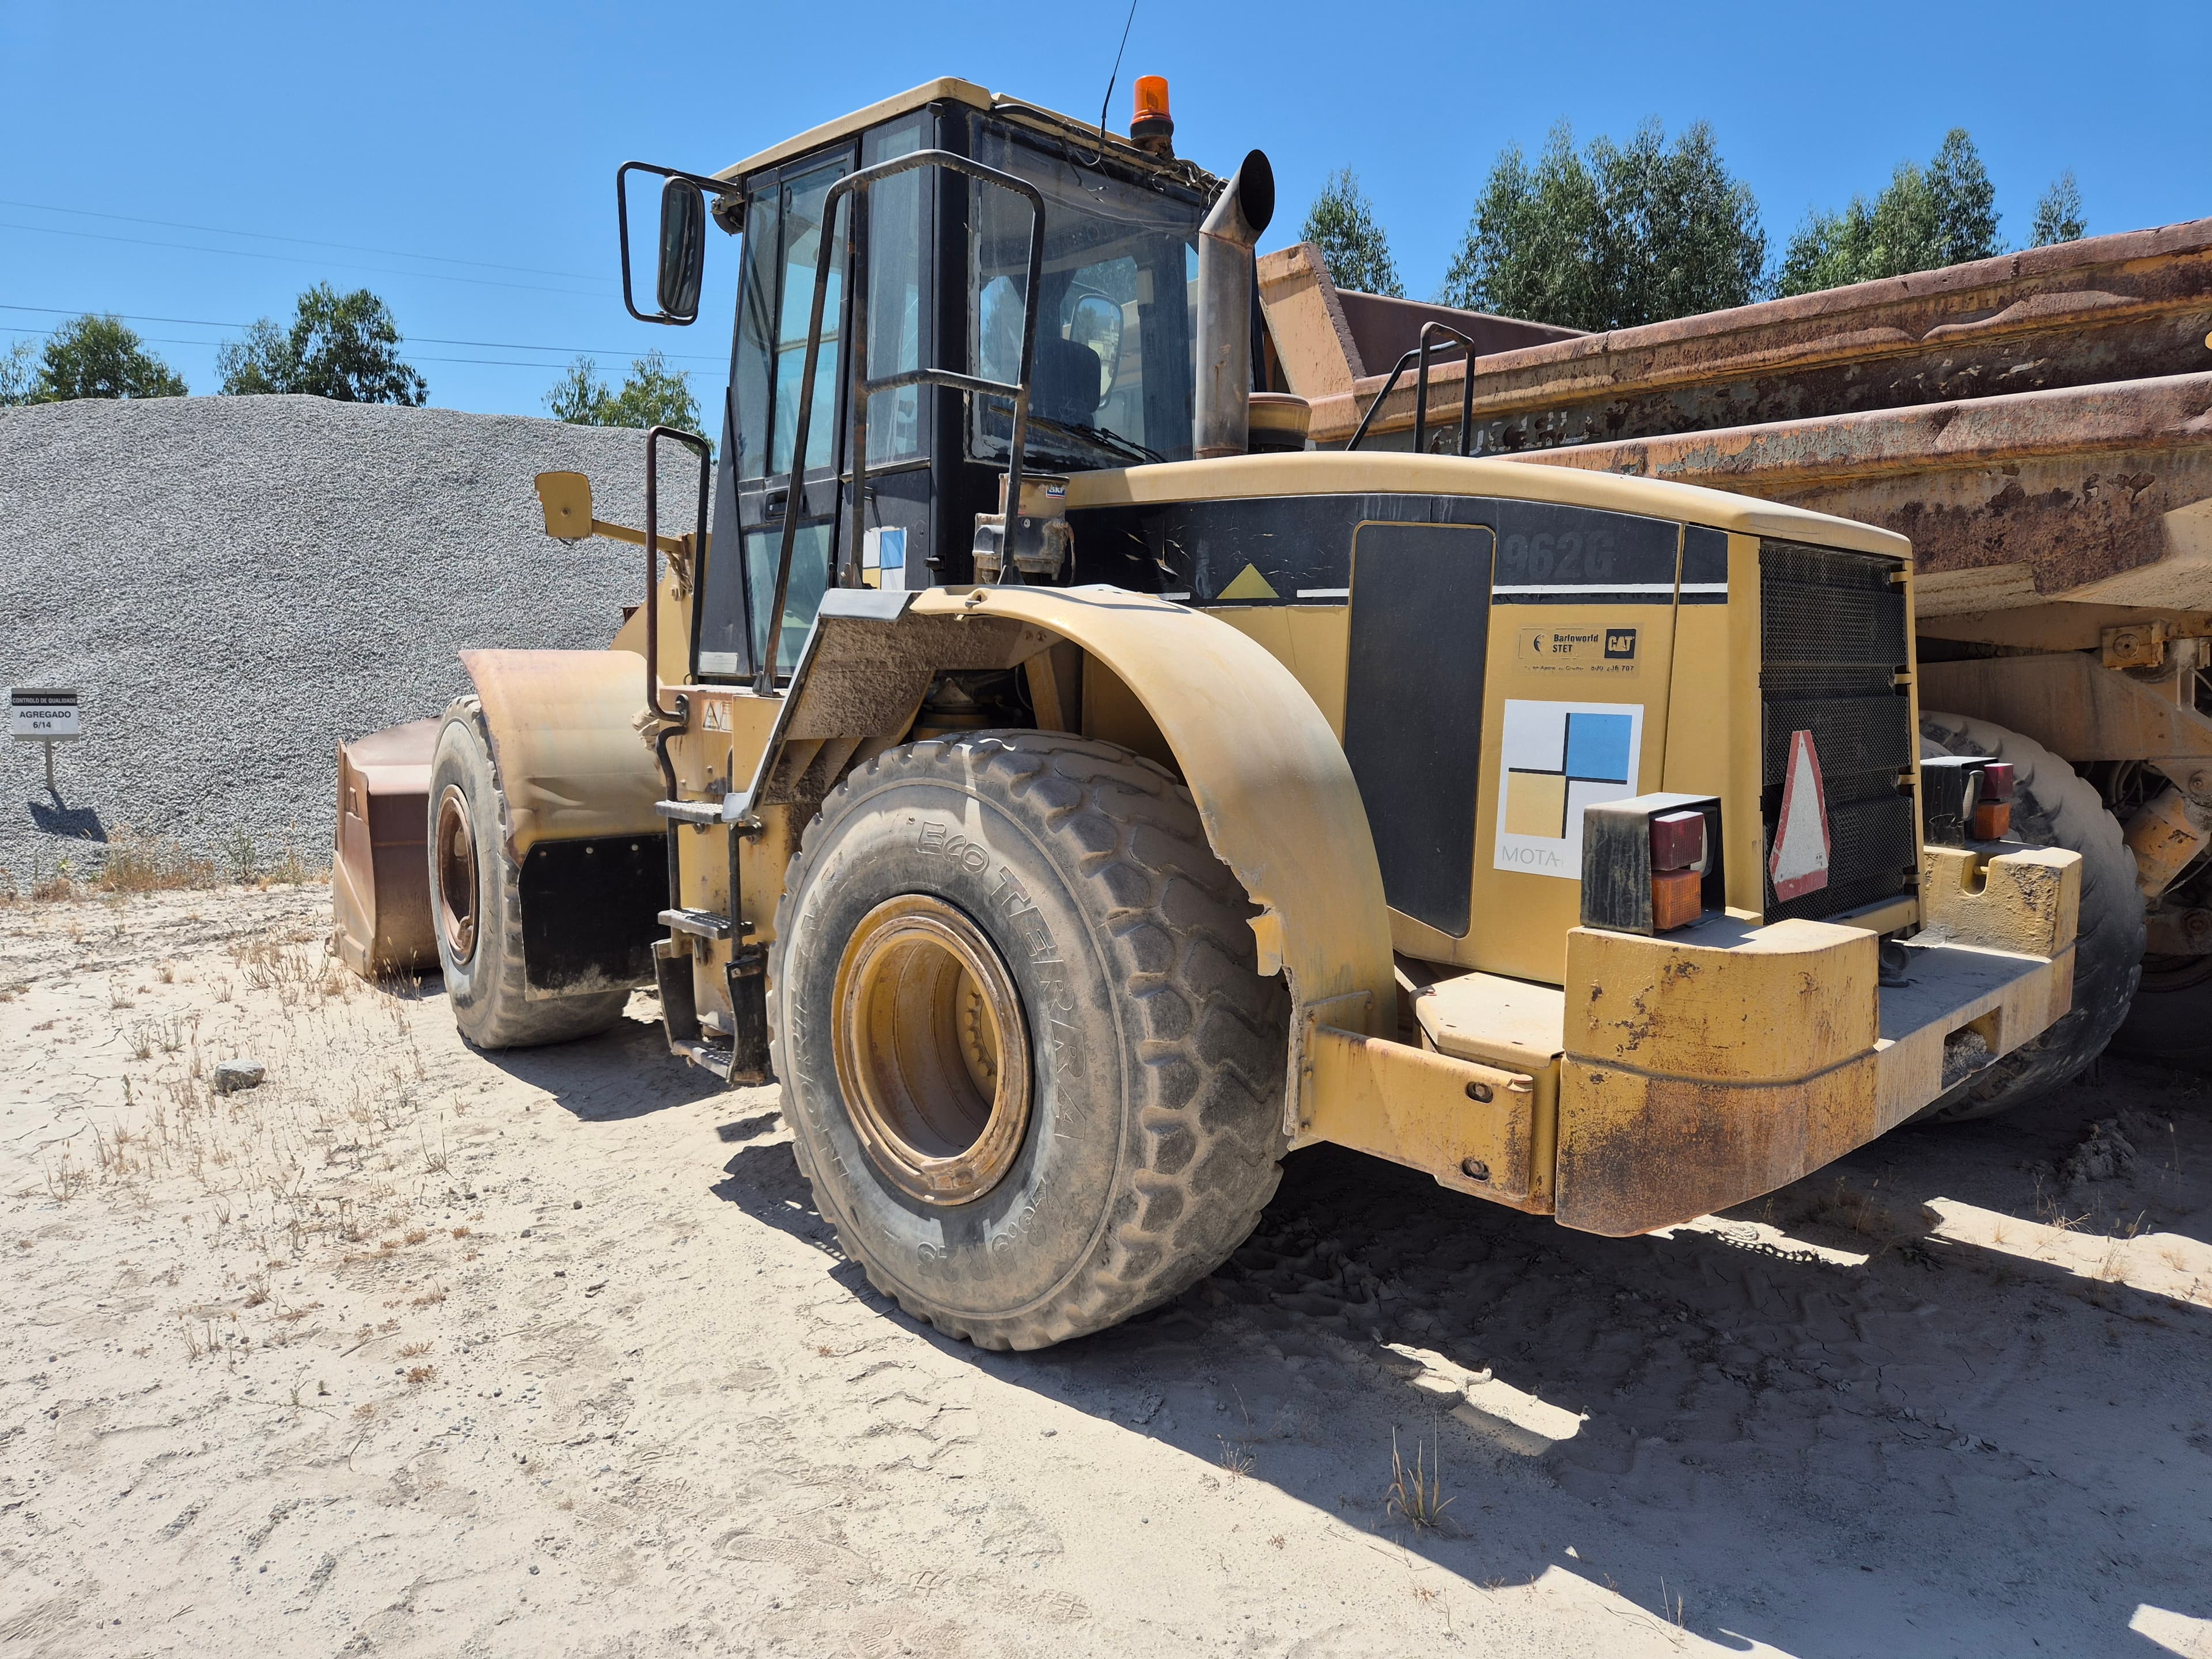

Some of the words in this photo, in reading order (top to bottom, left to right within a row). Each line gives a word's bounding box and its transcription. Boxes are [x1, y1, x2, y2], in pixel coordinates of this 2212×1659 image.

[1502, 529, 1613, 578] 962G
[1554, 634, 1599, 643] Barloworld
[1608, 635, 1634, 652] CAT
[1552, 644, 1573, 653] STET
[1502, 846, 1564, 868] MOTA-
